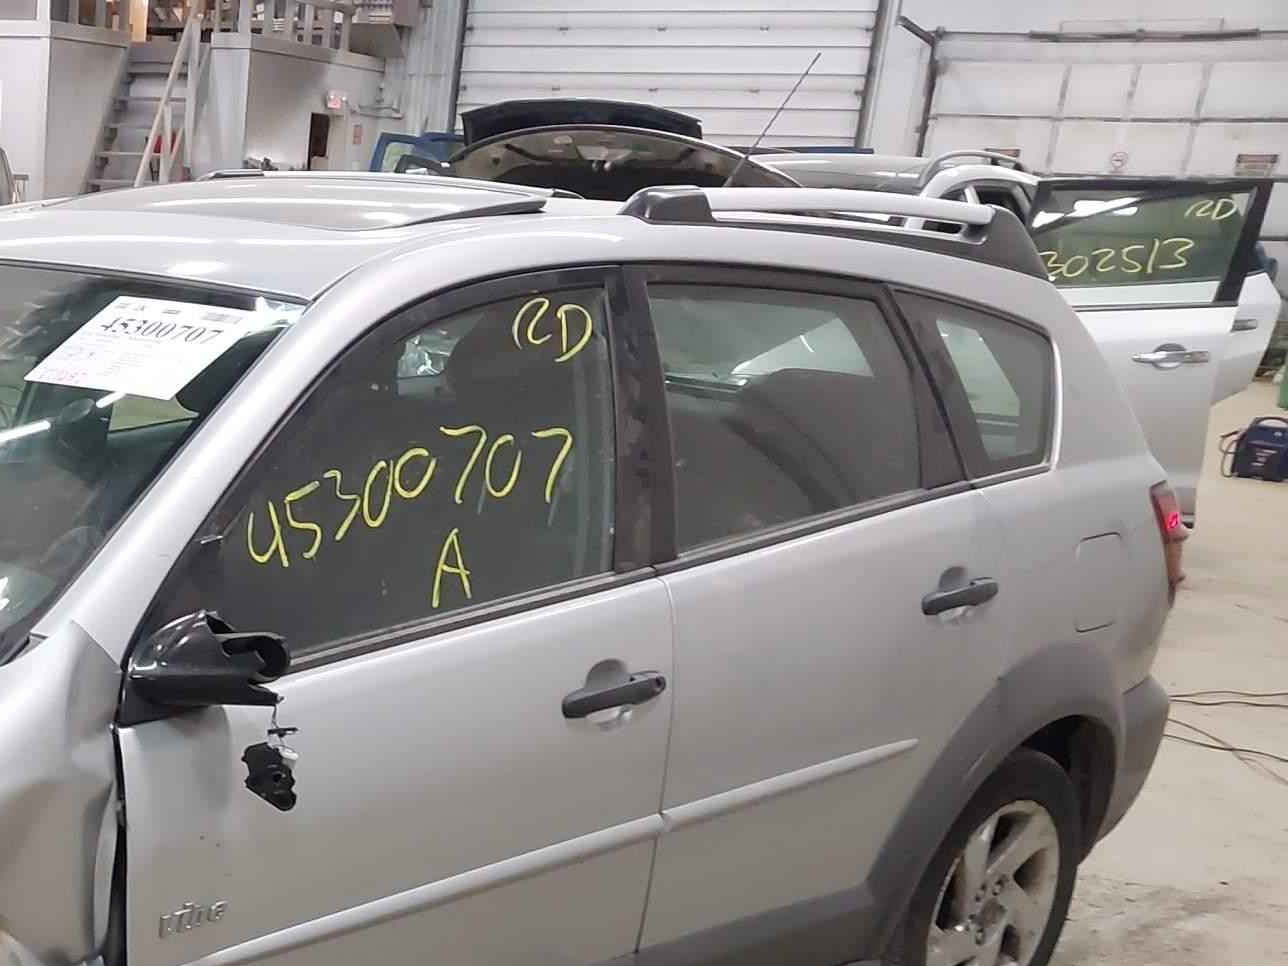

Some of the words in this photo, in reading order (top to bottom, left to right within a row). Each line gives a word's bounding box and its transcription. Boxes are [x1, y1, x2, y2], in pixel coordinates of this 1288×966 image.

[101, 316, 224, 345] 45300707
[247, 424, 573, 568] 45300707
[432, 527, 472, 608] A
